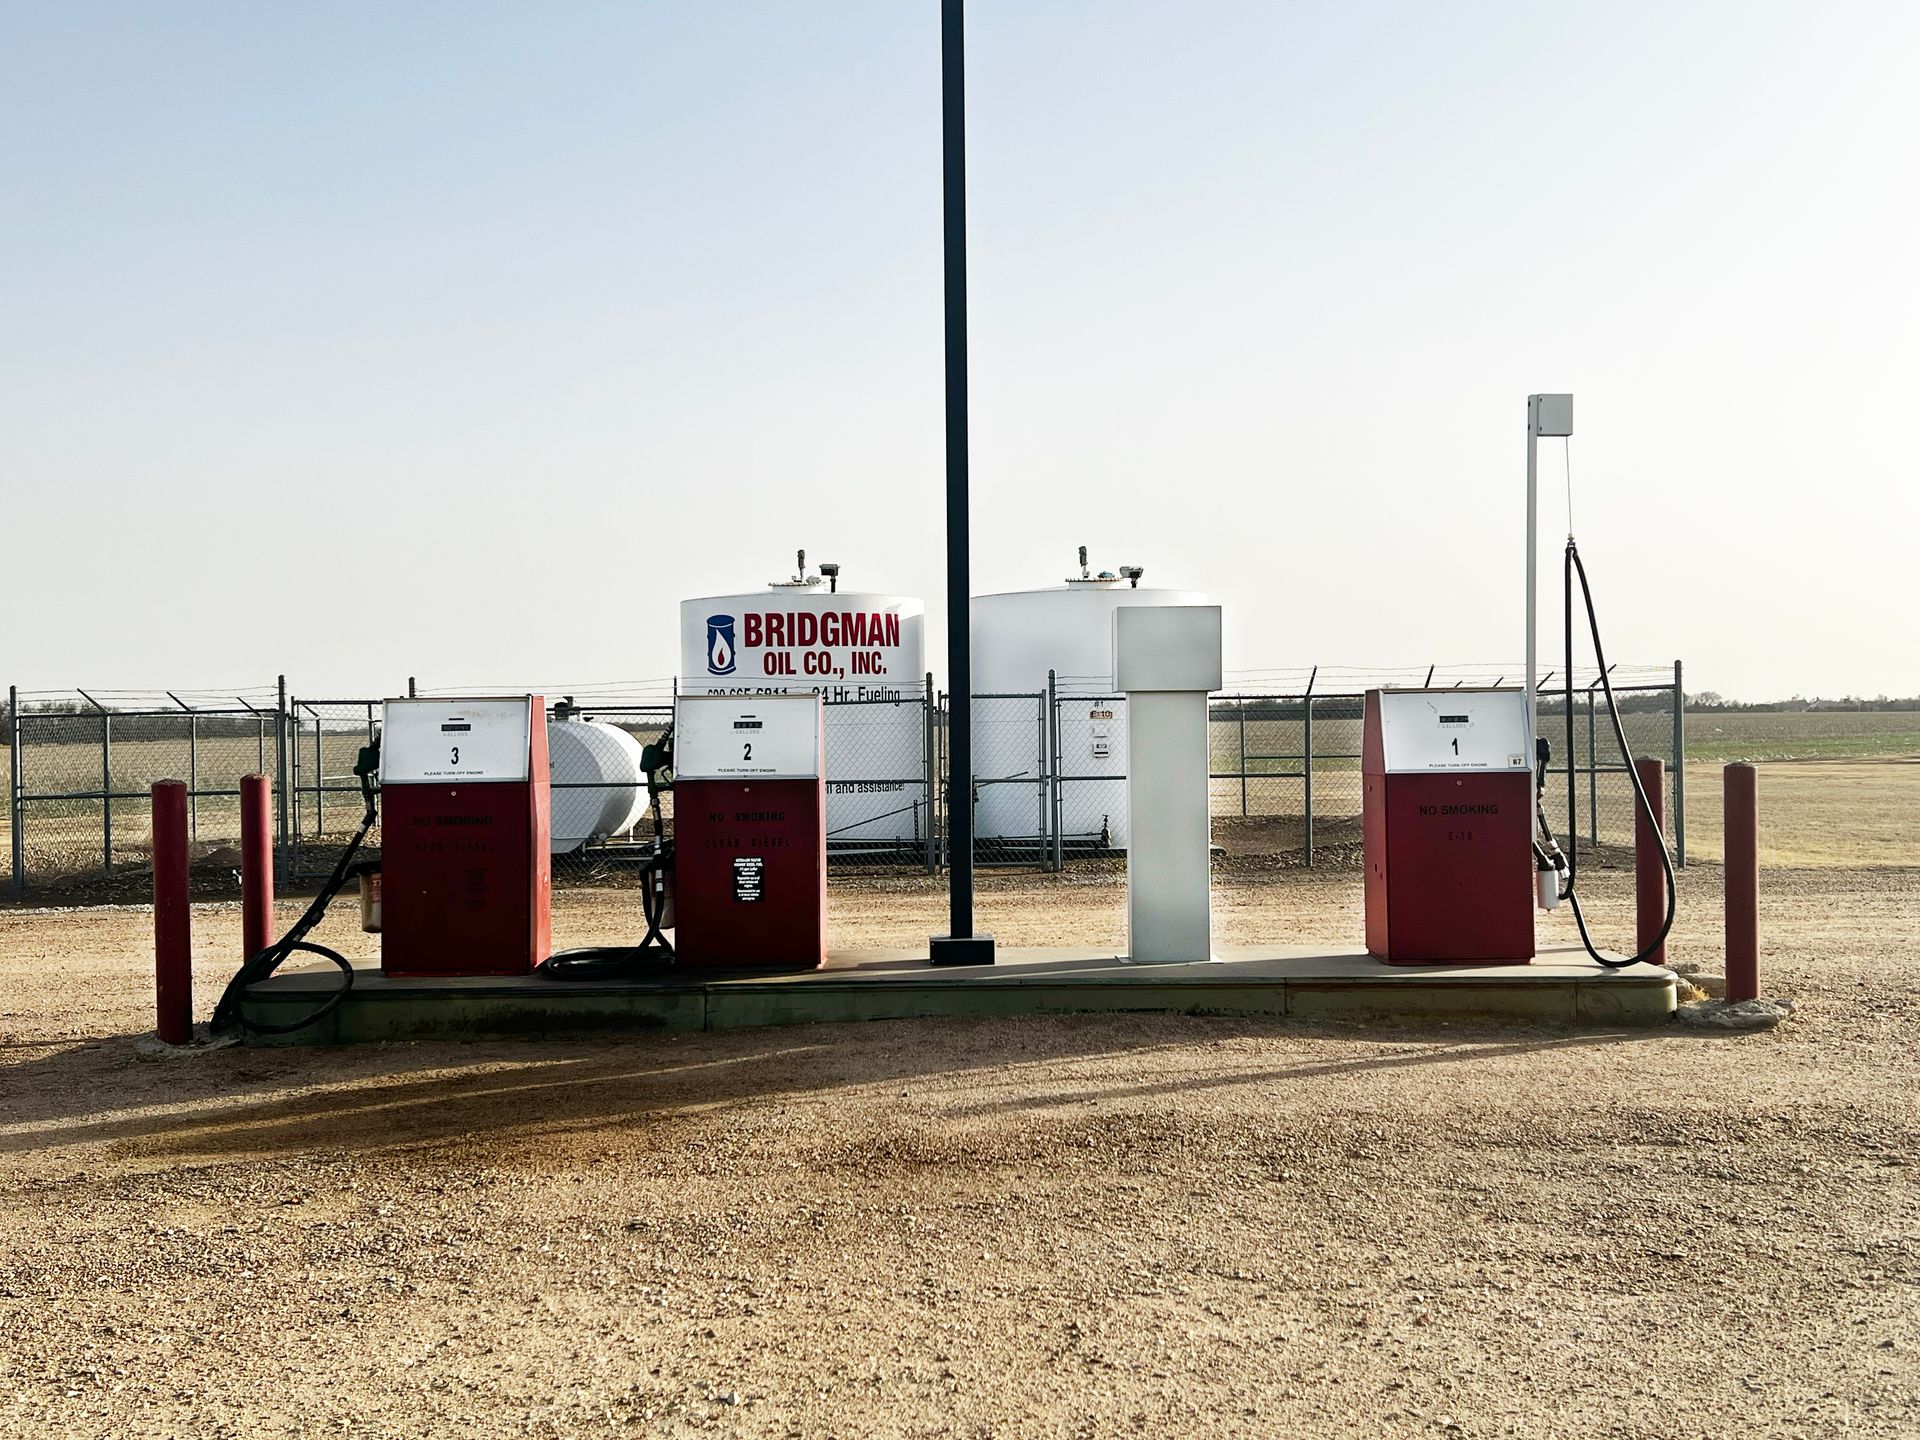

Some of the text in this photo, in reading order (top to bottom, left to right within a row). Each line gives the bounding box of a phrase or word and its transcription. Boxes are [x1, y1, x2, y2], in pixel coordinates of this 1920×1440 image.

[744, 612, 900, 647] BRIDGMAN
[763, 651, 887, 679] OIL CO., INC.
[833, 687, 853, 703] Hr.
[858, 686, 900, 707] Fueling
[743, 743, 752, 760] 2
[1451, 738, 1458, 755] 1
[451, 747, 459, 765] 3
[835, 783, 854, 794] and
[709, 811, 785, 822] NO SMOKING
[1419, 805, 1499, 816] NO SMOKING
[413, 815, 493, 826] NO SMOKING
[751, 837, 791, 848] DIESEL
